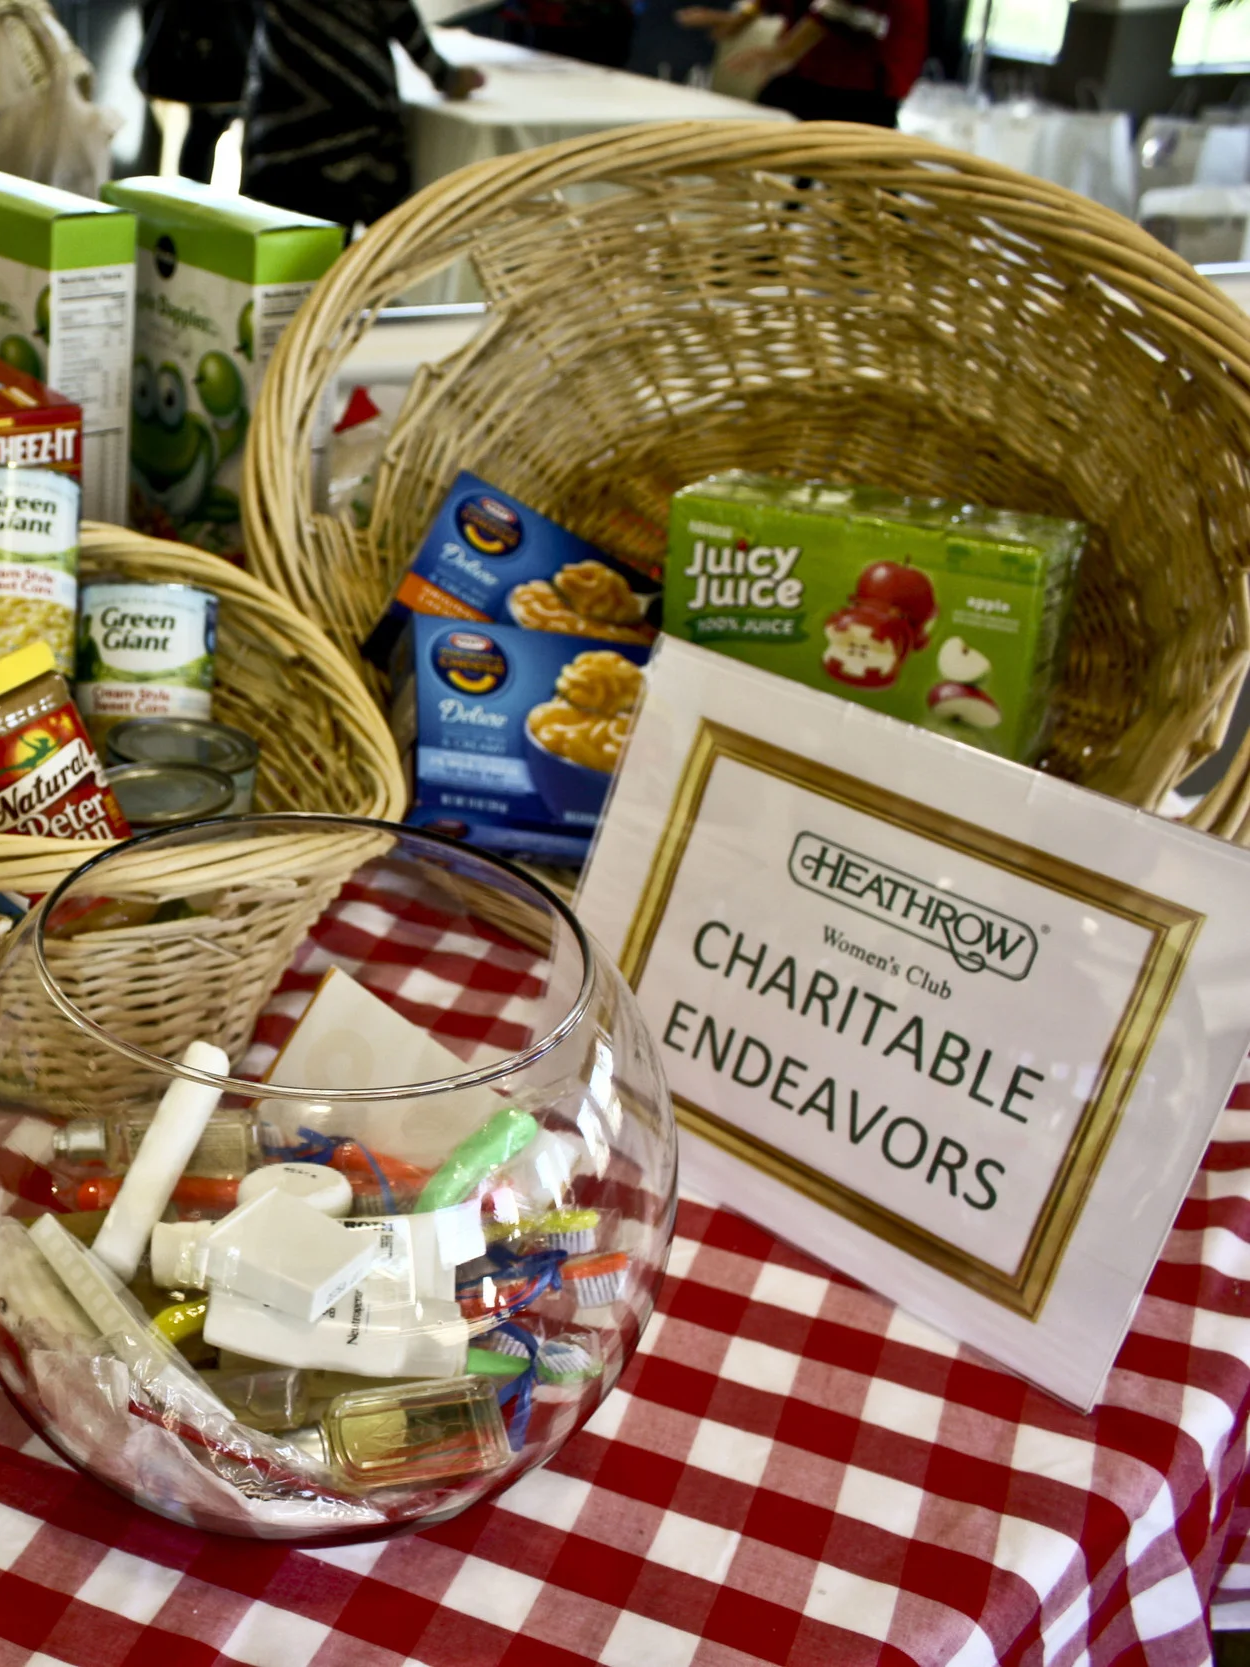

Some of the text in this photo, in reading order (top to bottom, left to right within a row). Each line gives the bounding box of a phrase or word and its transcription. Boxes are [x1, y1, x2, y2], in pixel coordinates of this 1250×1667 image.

[25, 569, 53, 585] Style
[439, 542, 499, 586] Deluxe
[684, 538, 801, 580] Juicy
[687, 574, 803, 610] Juice
[965, 596, 1010, 615] apple
[101, 607, 176, 631] Green
[103, 629, 171, 652] Giant
[438, 698, 508, 727] Deluxe
[800, 845, 1026, 973] HEATHROW
[822, 924, 953, 1000] Women's Club
[693, 920, 1045, 1124] CHARITABLE
[662, 1000, 1006, 1211] ENDEAVORS
